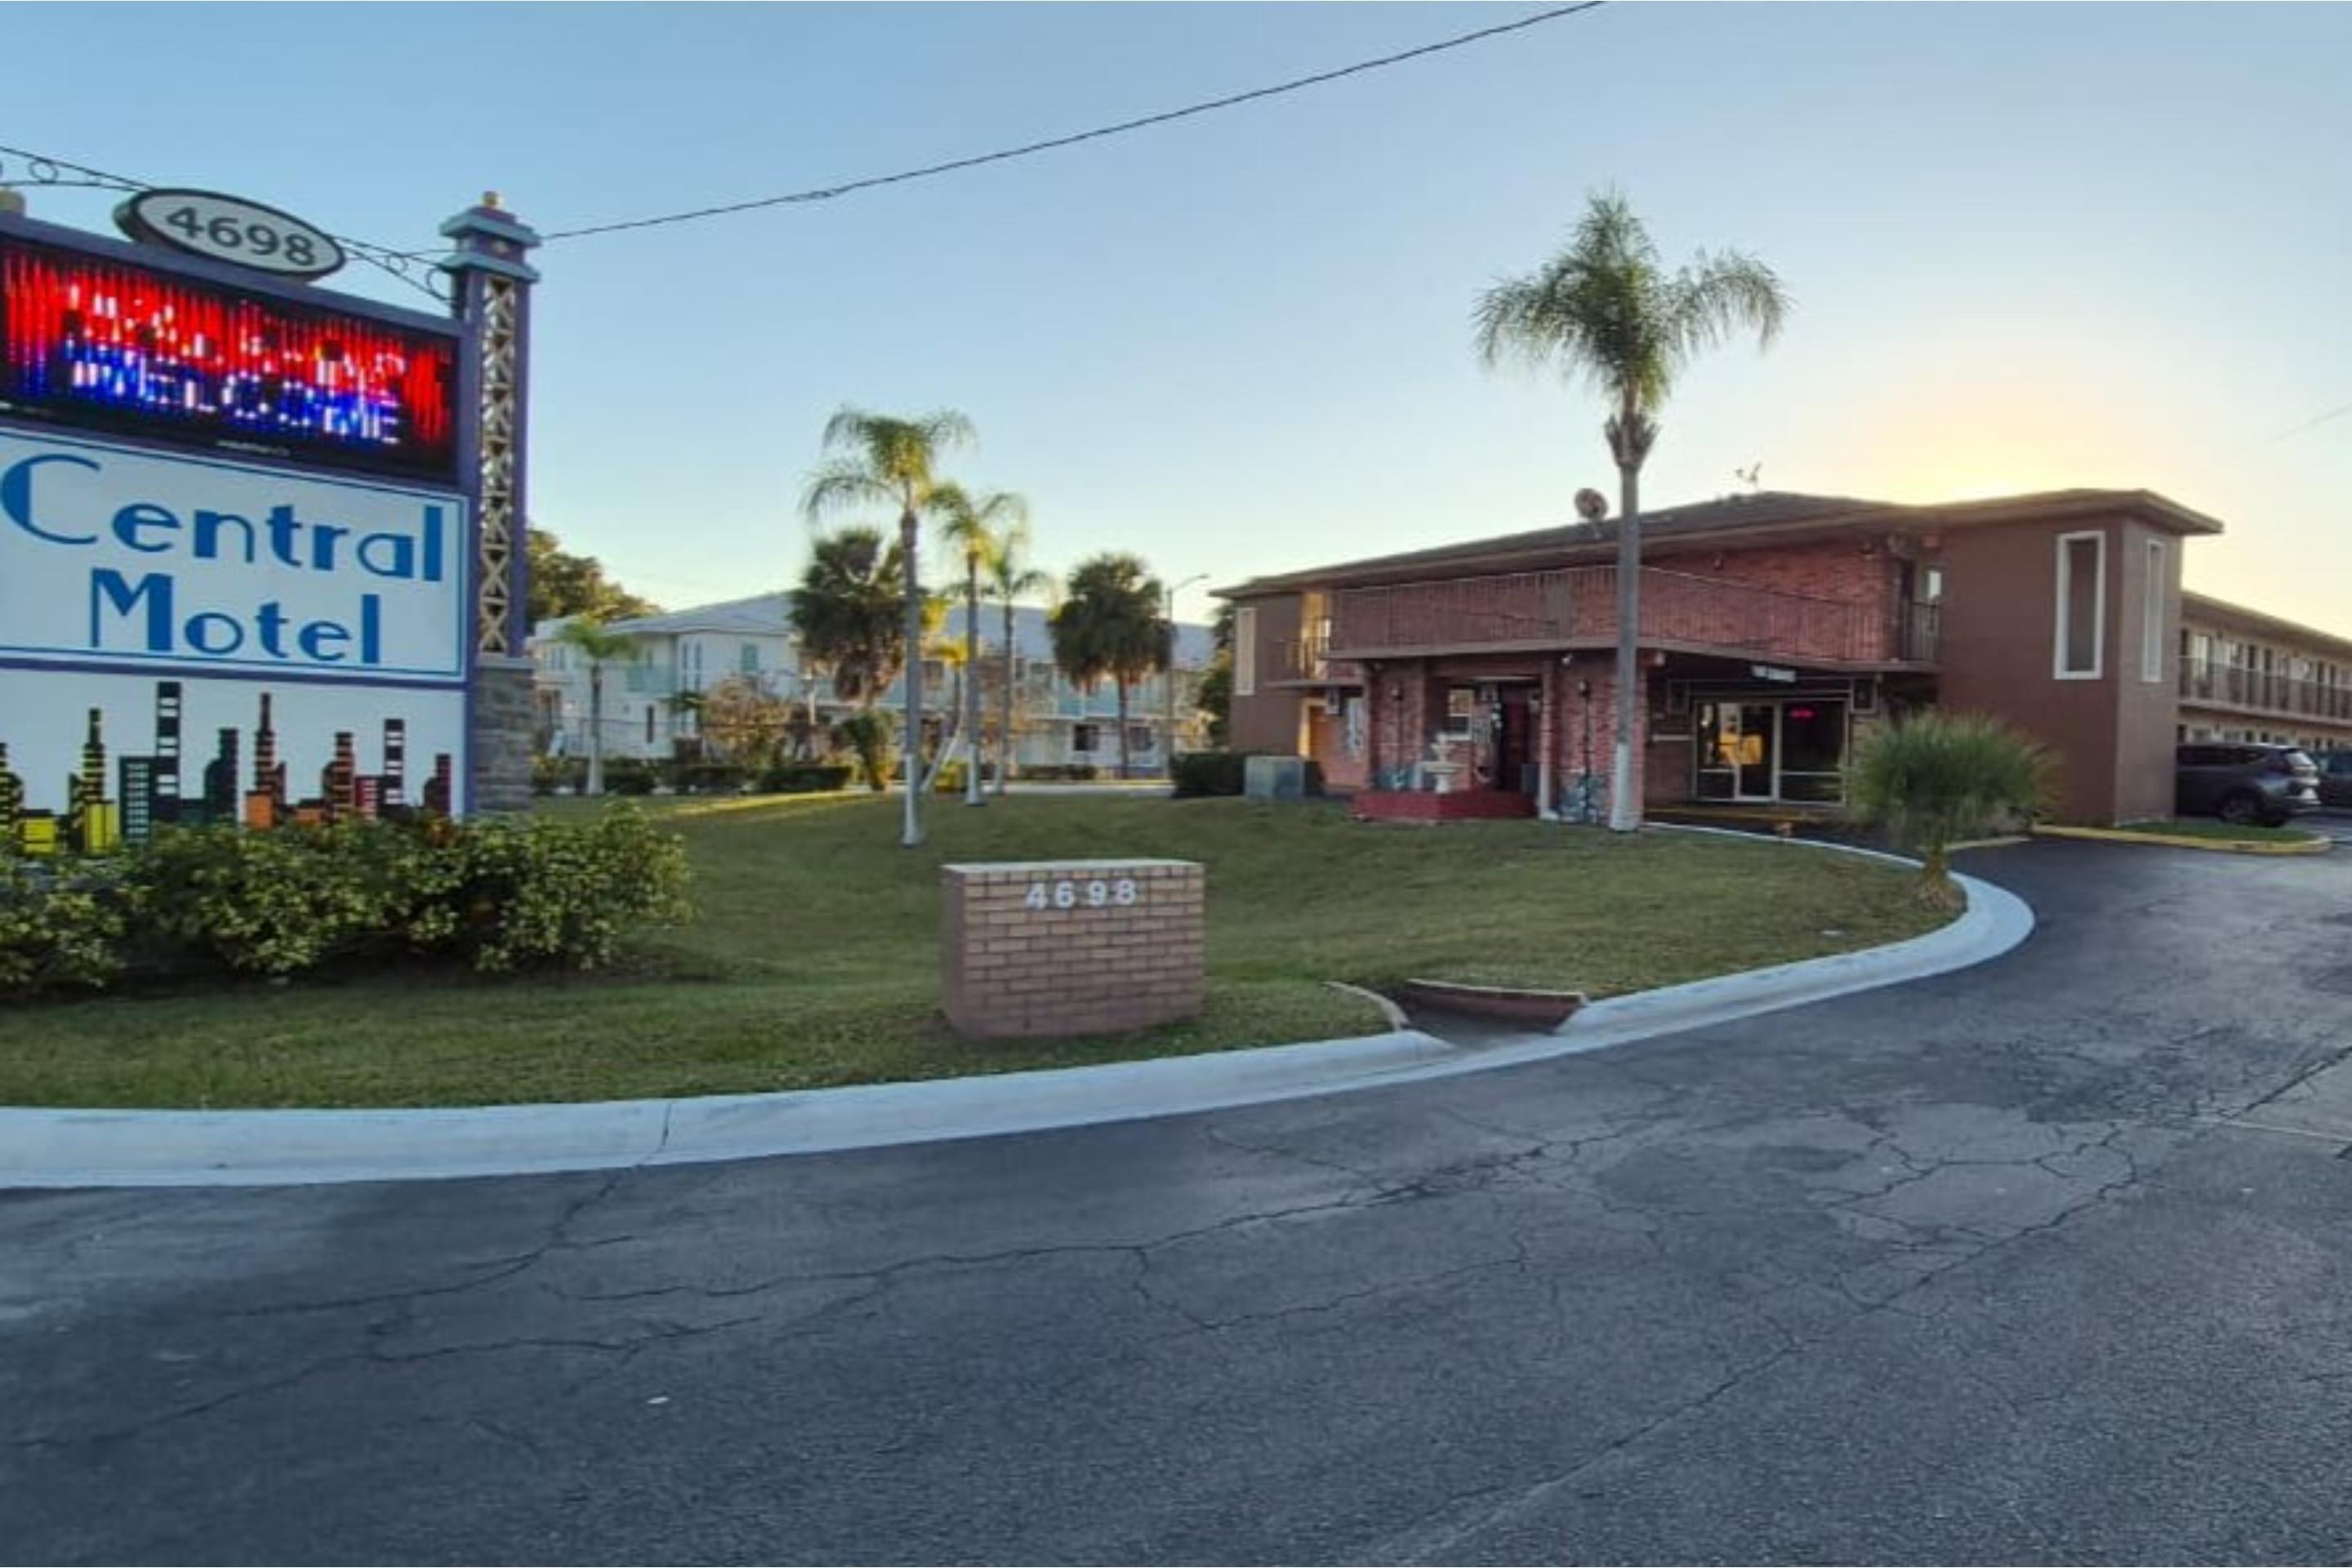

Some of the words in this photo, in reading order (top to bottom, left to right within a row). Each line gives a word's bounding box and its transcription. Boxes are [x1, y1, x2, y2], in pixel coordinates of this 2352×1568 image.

[166, 206, 318, 268] 4698
[0, 453, 443, 581] Central
[90, 567, 381, 664] Motel
[1026, 878, 1137, 909] 4698
